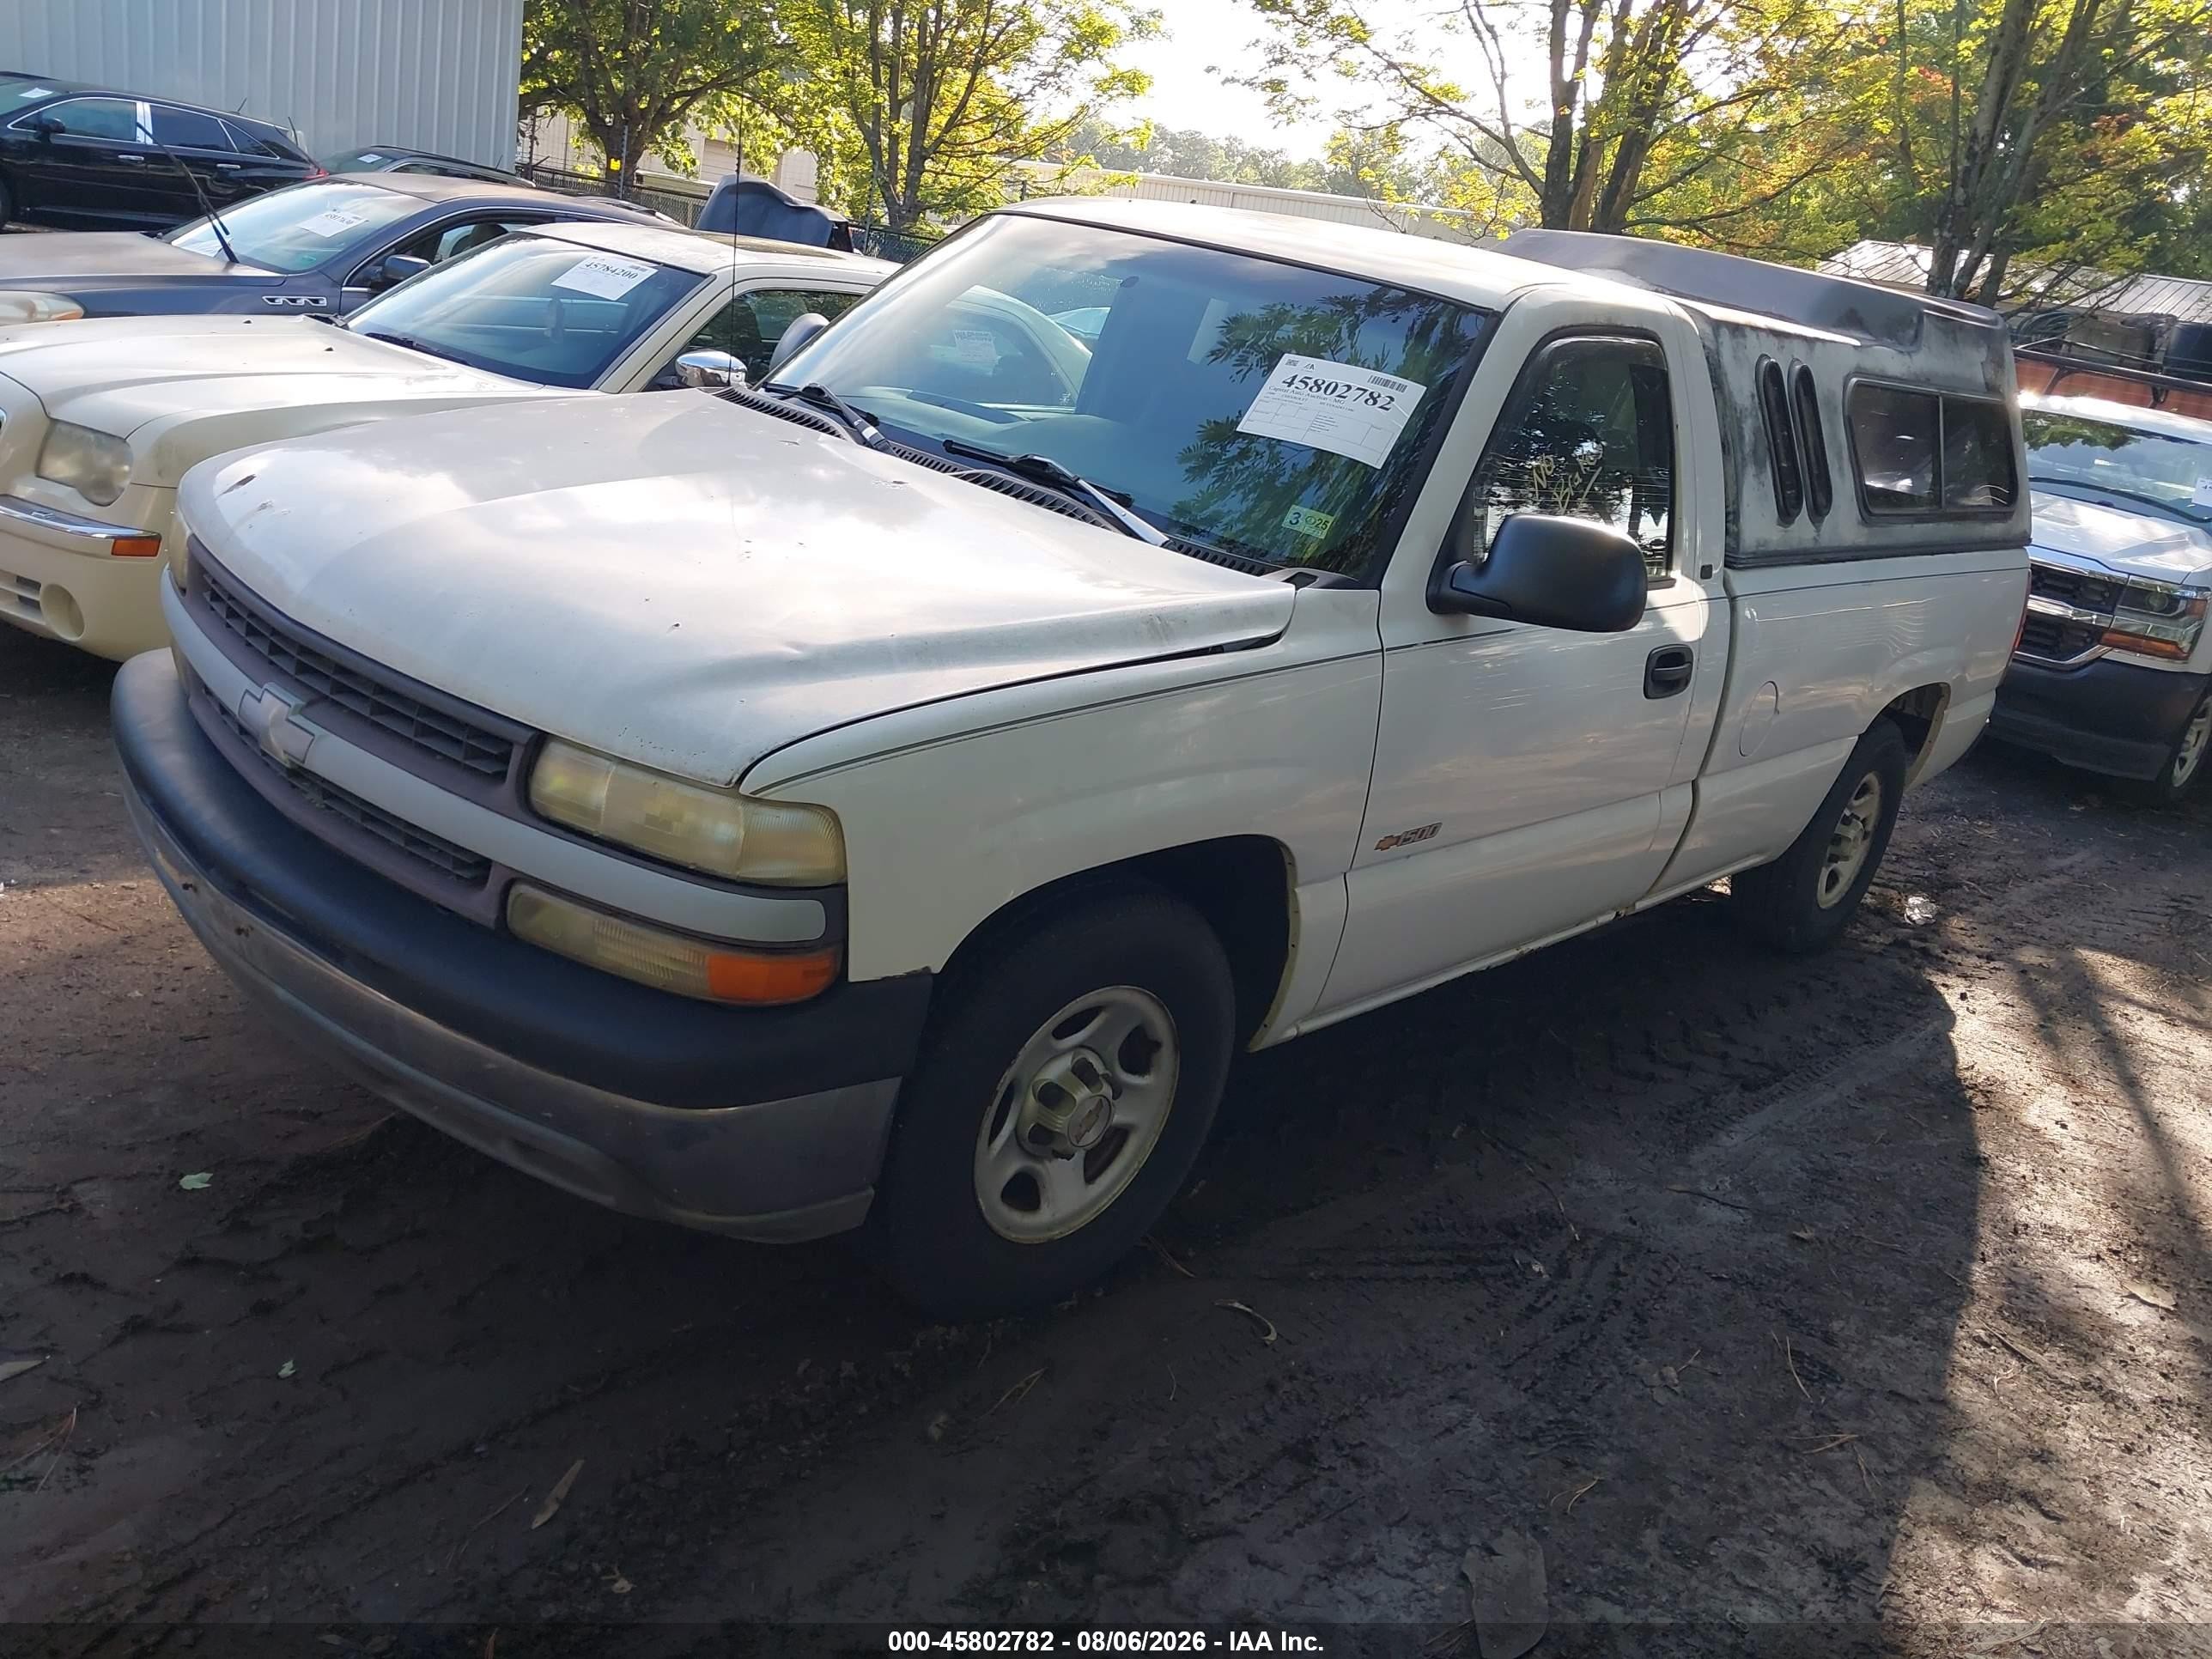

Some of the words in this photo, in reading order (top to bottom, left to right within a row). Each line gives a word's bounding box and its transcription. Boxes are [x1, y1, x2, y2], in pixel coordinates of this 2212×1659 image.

[584, 262, 639, 279] 45784200
[1282, 374, 1395, 411] 45802782
[1305, 392, 1328, 402] Auction
[1289, 512, 1302, 526] 3
[1315, 518, 1329, 531] 25
